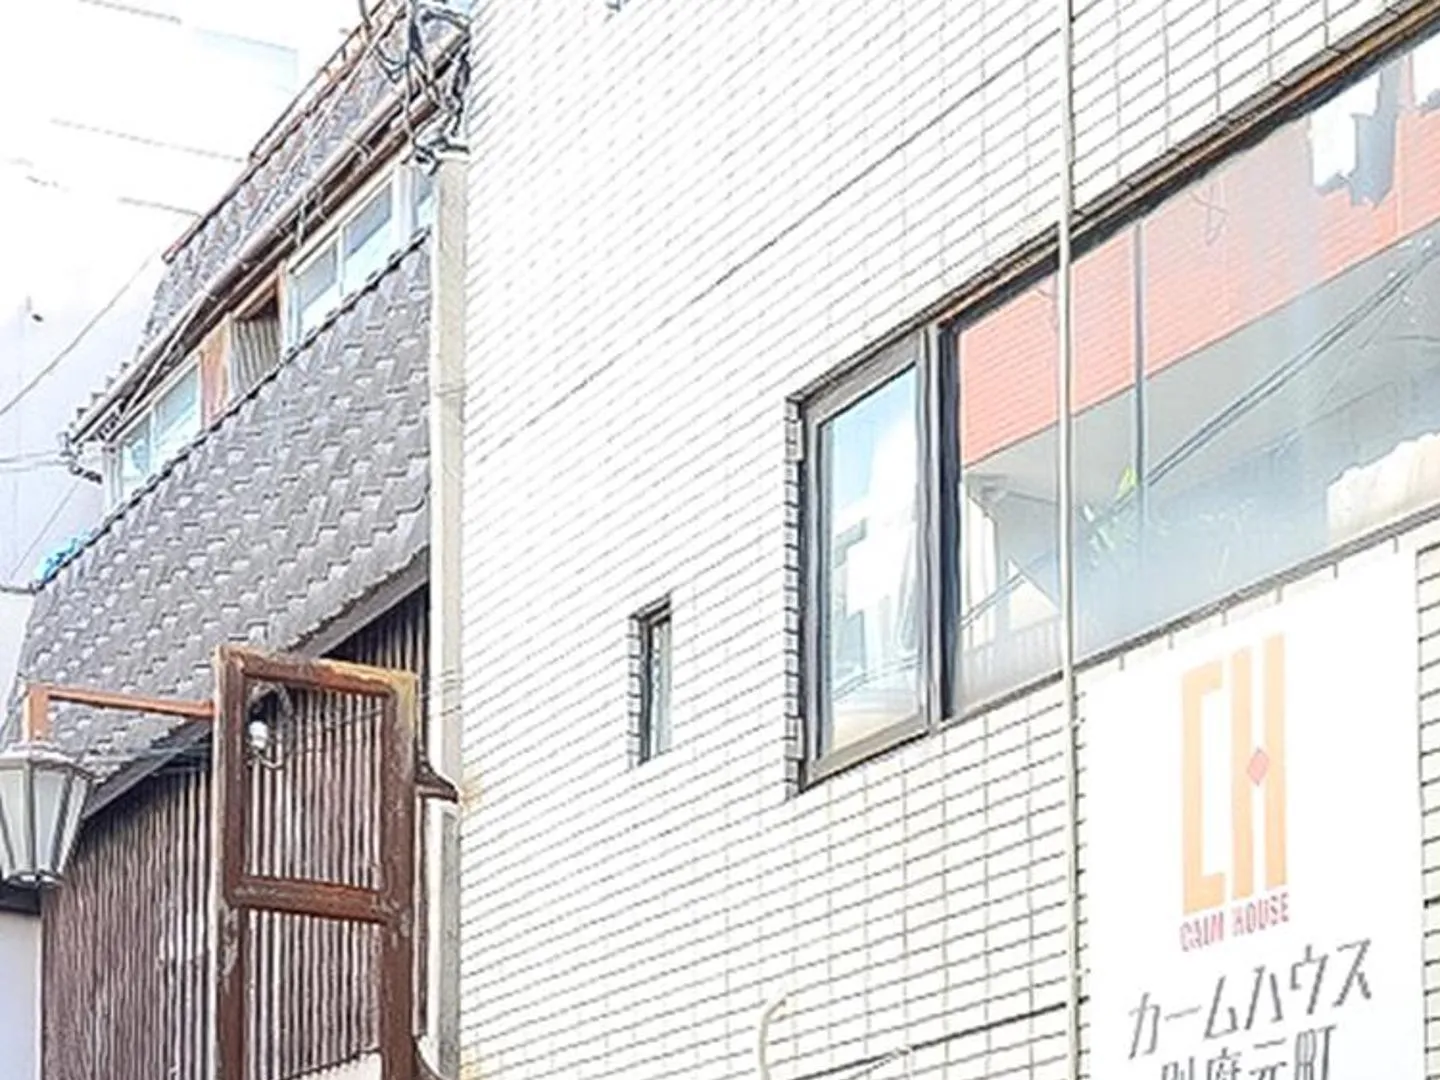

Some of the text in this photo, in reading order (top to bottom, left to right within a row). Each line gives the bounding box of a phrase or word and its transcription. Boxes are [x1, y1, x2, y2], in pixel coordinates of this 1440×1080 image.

[1232, 892, 1289, 937] HOUSE
[1128, 938, 1373, 1061] カームハウス
